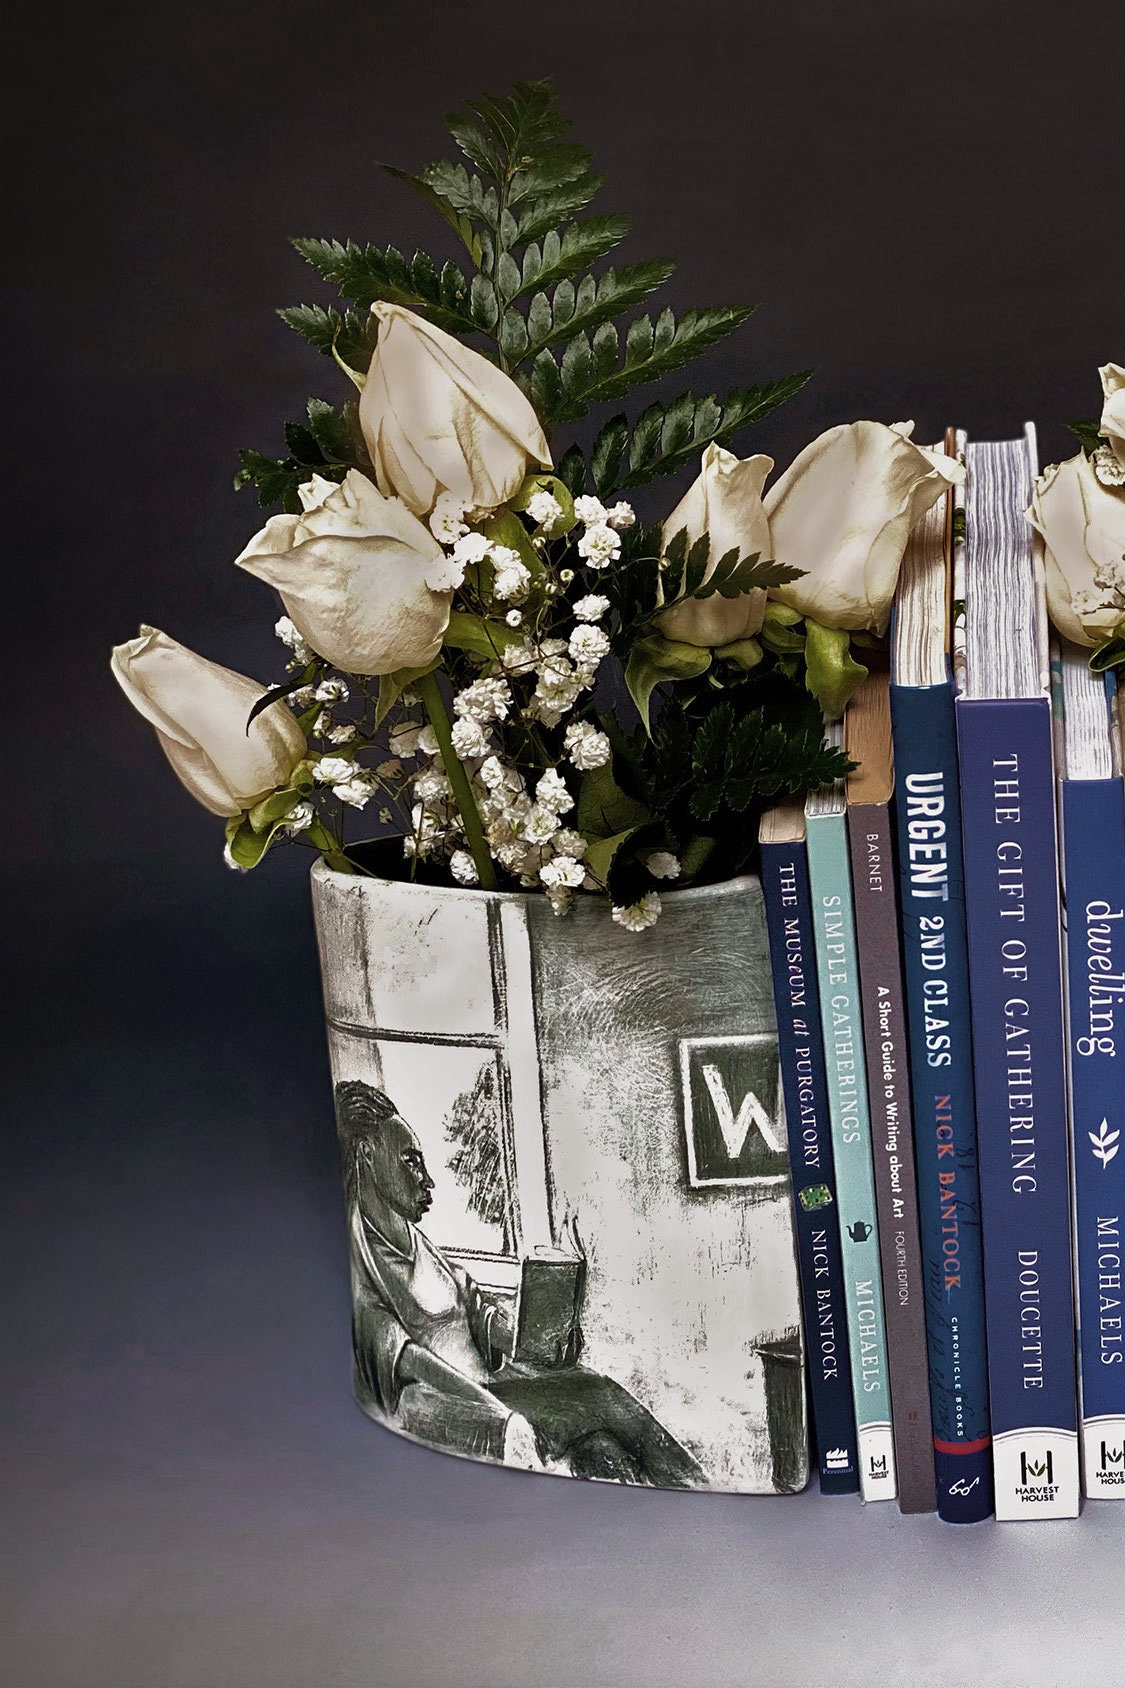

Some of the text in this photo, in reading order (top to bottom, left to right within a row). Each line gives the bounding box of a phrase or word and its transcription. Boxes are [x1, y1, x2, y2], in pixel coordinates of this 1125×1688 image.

[779, 862, 798, 907] THE
[866, 833, 882, 893] BARNET
[905, 772, 952, 1068] URGENT 2ND CLASS
[793, 1019, 810, 1037] at
[823, 895, 861, 1144] SIMPLE GATHERINGS
[993, 753, 1037, 1194] THE GIFT OF GATHERING
[1077, 900, 1125, 1058] dwelling
[795, 1047, 820, 1169] PURGATORY
[877, 986, 904, 1218] A Short Guide to Writing about Art
[934, 1094, 954, 1159] NICK
[895, 1230, 909, 1306] FOURTH EDITION
[938, 1171, 961, 1291] BANTOCK
[1097, 1216, 1123, 1365] MICHAELS
[811, 1229, 838, 1380] NICK BANTOCK
[855, 1280, 881, 1392] MICHAELS
[1018, 1250, 1043, 1389] DOUCETTE
[952, 1316, 964, 1437] CHRONICLE BOOKS
[1015, 1486, 1059, 1495] HARVEST
[1021, 1493, 1055, 1502] HOUSE
